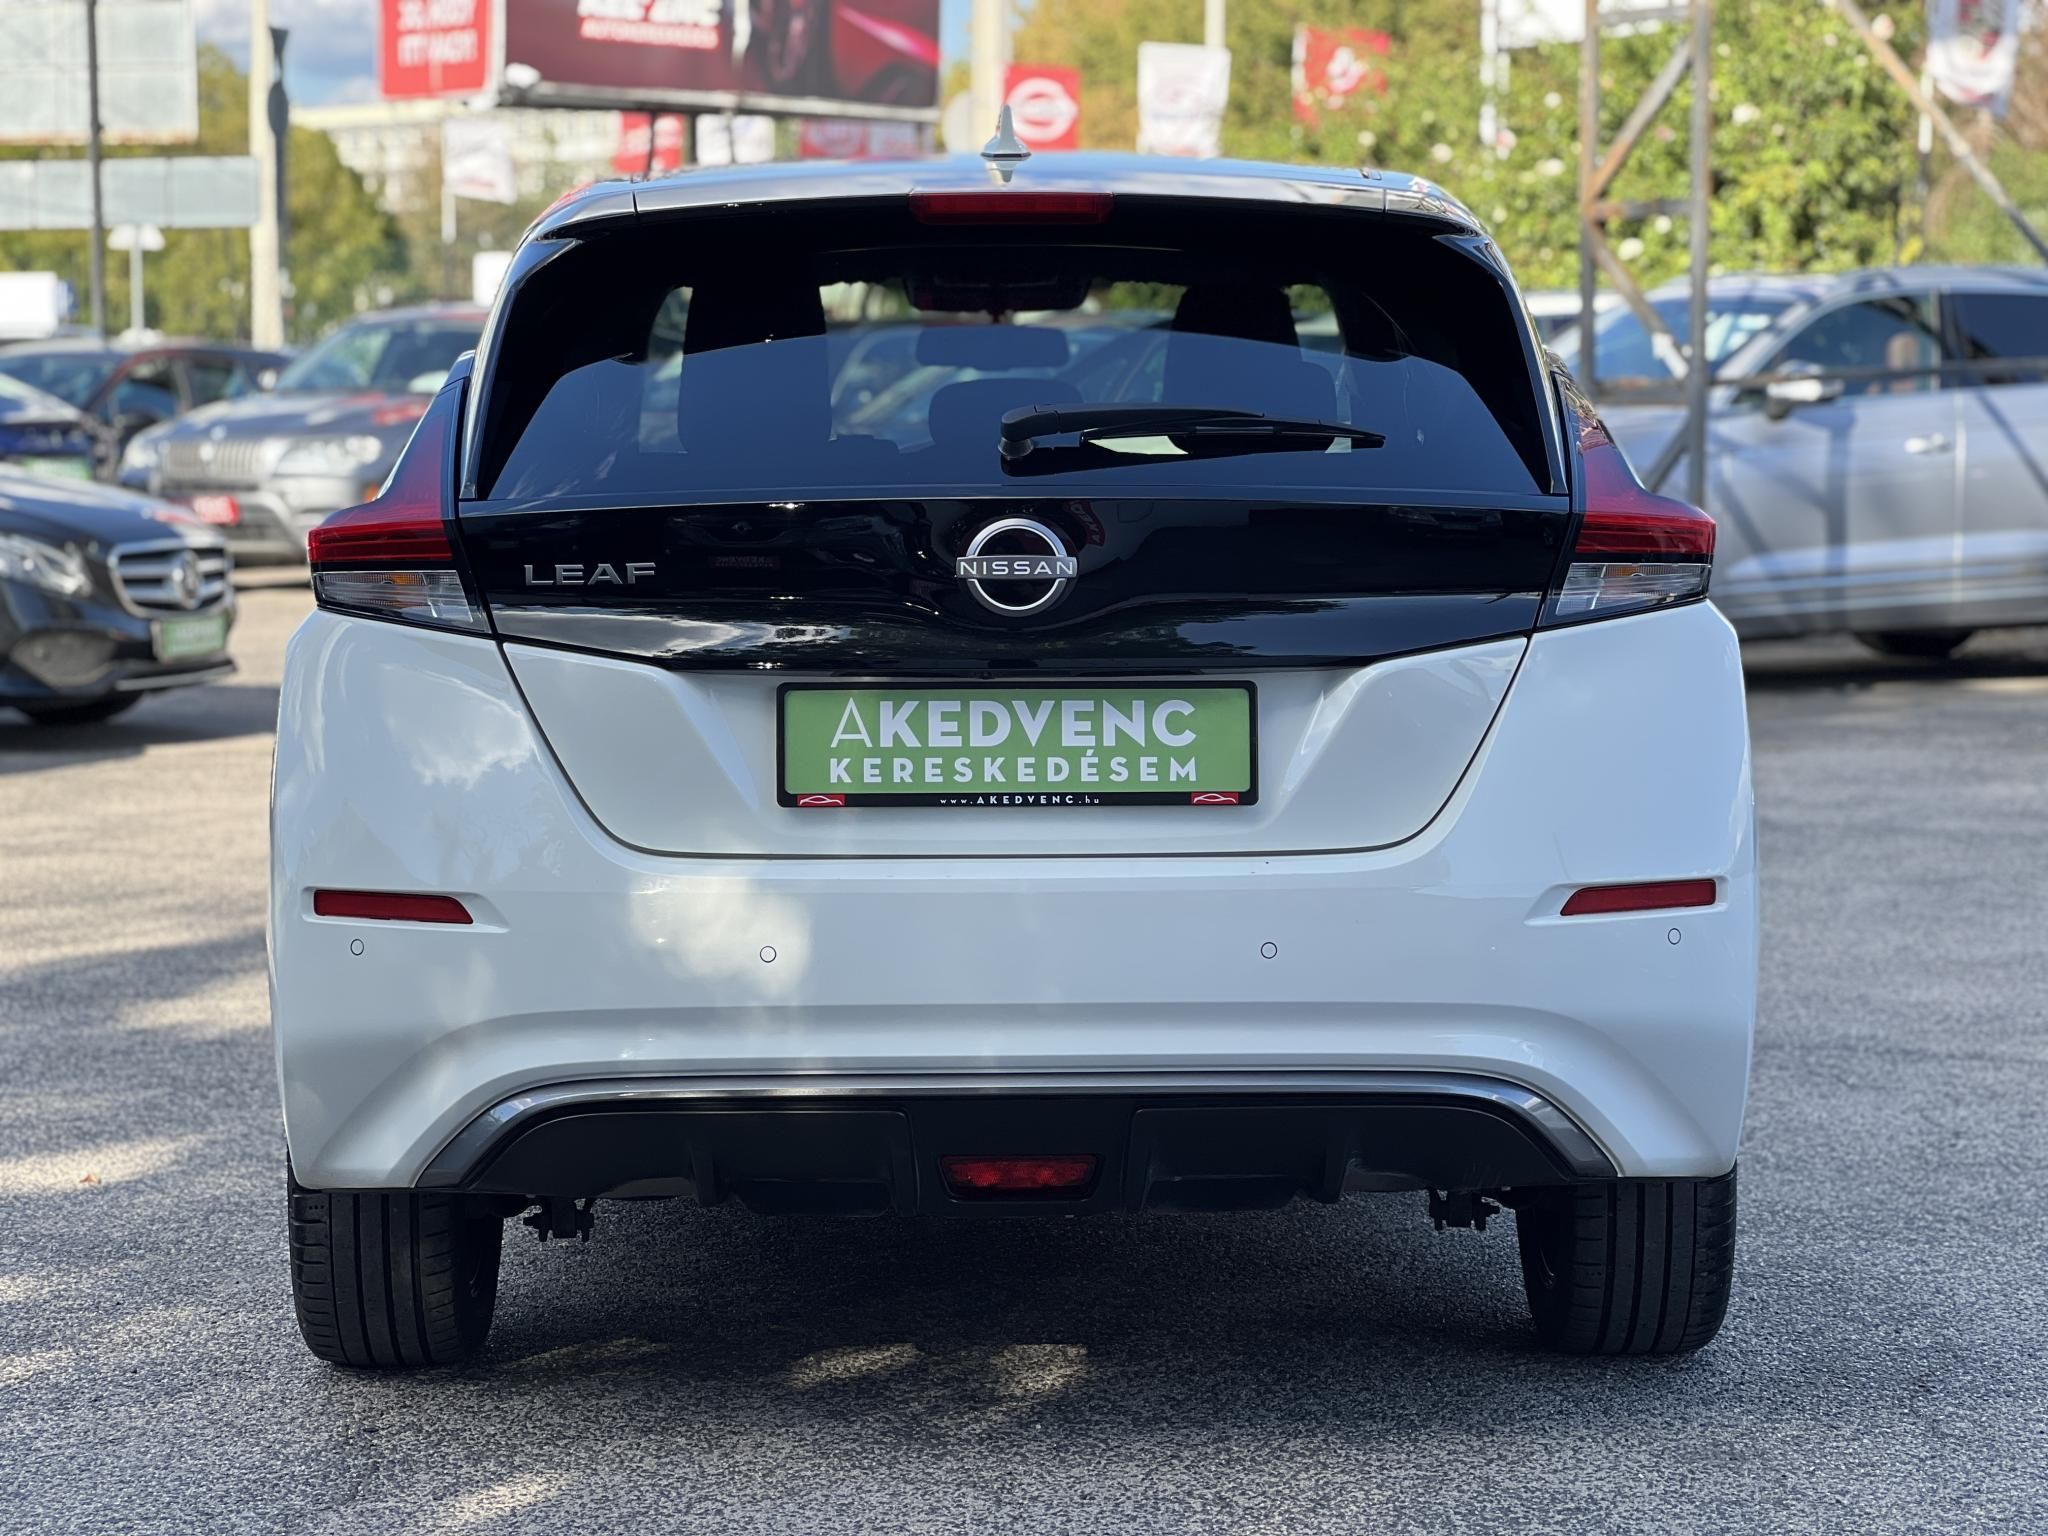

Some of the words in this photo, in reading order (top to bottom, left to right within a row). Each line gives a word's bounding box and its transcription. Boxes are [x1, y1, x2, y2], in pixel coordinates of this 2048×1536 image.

[524, 562, 656, 586] LEAF
[959, 560, 1074, 576] NISSAN
[829, 750, 1198, 784] KERESKEDÉSEM
[939, 795, 1100, 805] www.AKEDVENC.hu
